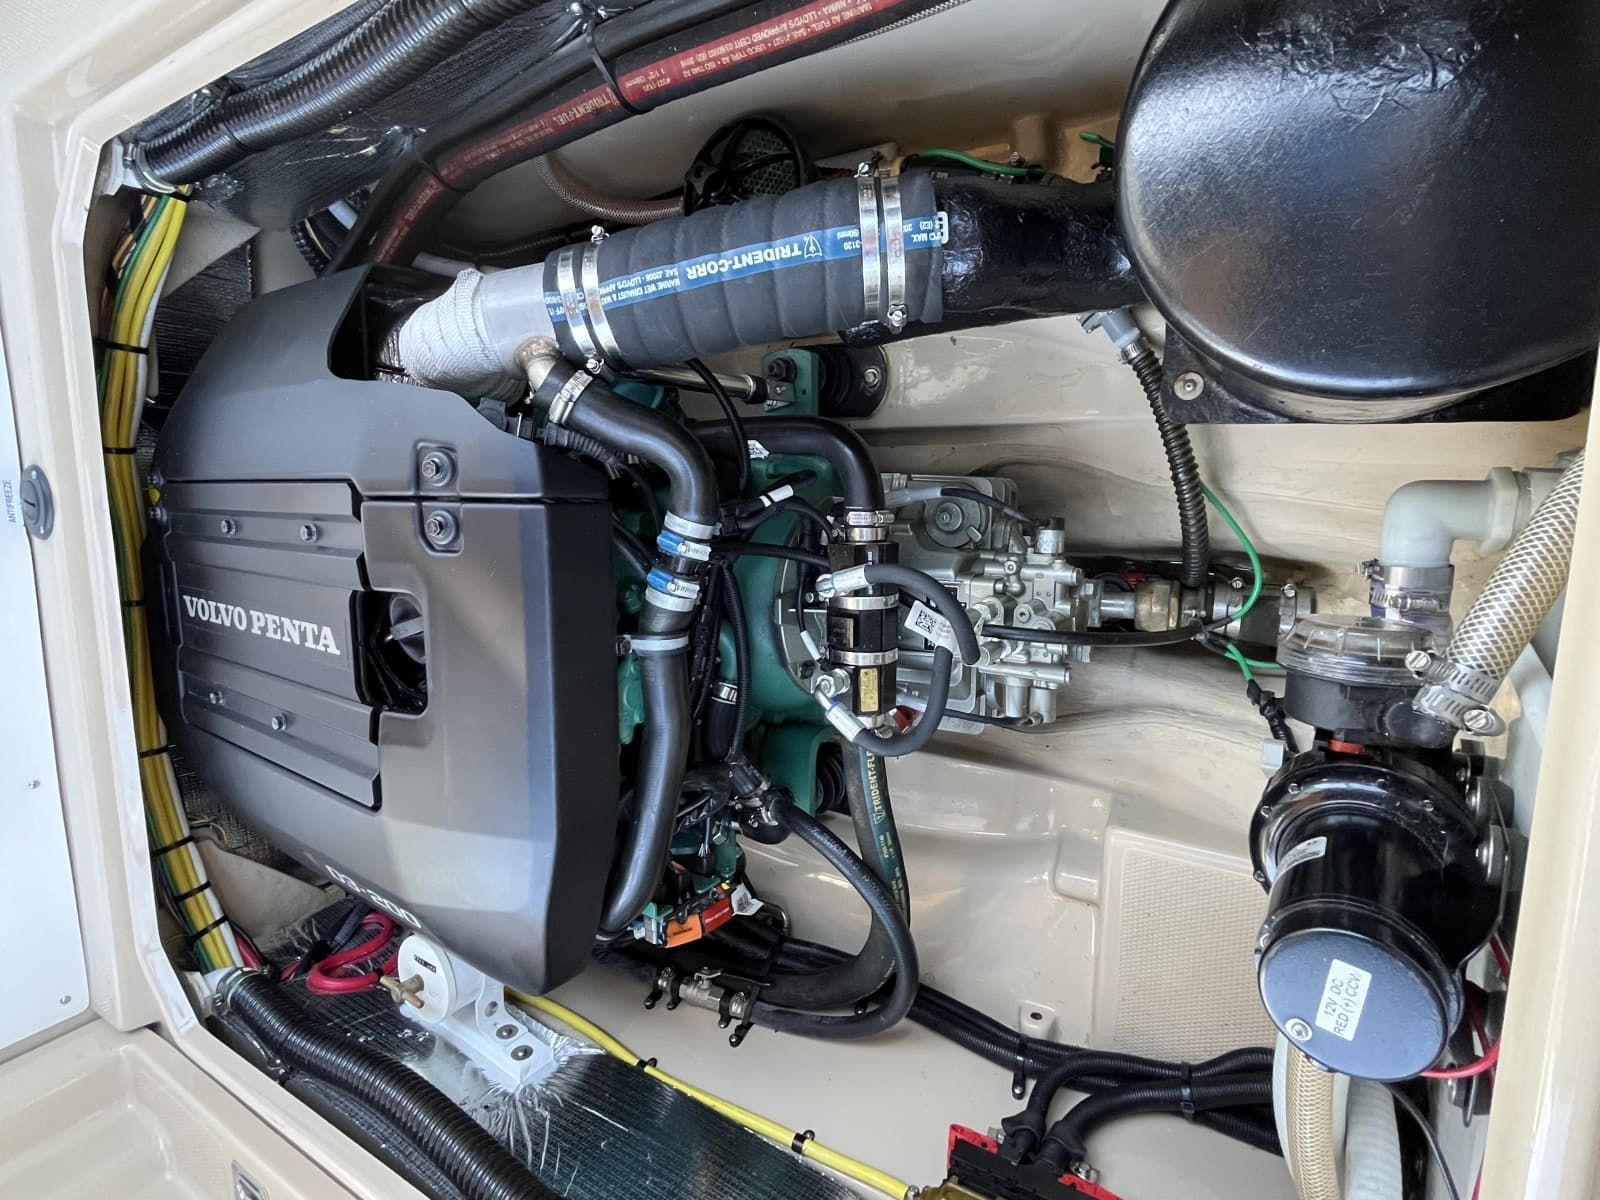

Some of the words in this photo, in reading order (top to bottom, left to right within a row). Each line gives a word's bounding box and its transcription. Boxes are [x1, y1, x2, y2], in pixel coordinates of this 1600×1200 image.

[830, 13, 841, 25] A2
[840, 1, 873, 21] MARINE
[751, 21, 788, 42] APPROVED
[790, 26, 807, 40] SAE
[809, 17, 831, 32] FUEL
[551, 91, 610, 127] TRIDENT-FUEL
[685, 241, 802, 280] TRIDENT-CORR
[664, 266, 679, 278] SAE
[617, 286, 643, 300] EXHAUST
[642, 283, 656, 294] WET
[656, 277, 681, 290] MARINE
[2, 479, 16, 522] ANTIFREEZE
[182, 594, 247, 630] VOLVO
[249, 609, 340, 655] PENTA
[324, 864, 421, 928] D3-200
[1328, 977, 1344, 995] DC
[1322, 996, 1339, 1017] 12V
[1338, 996, 1357, 1015] (+)
[1332, 1011, 1350, 1036] RED
